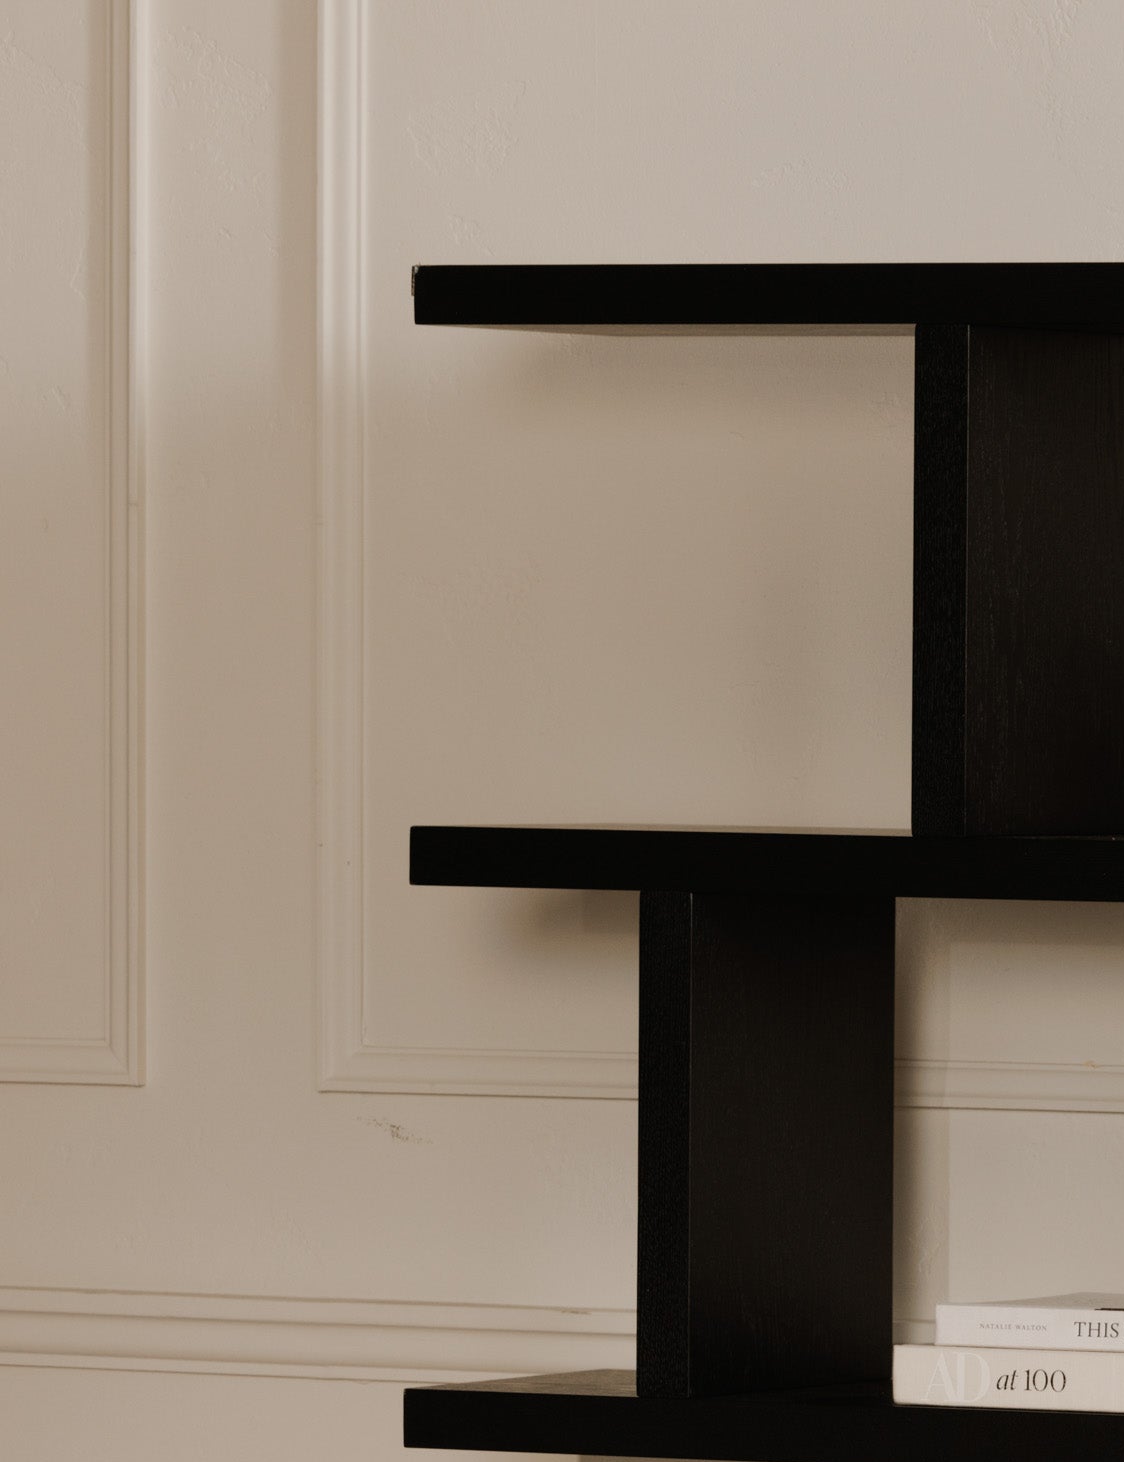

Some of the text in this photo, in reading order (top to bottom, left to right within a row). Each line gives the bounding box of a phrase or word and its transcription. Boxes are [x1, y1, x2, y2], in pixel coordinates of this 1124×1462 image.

[979, 1322, 1048, 1332] NATALIE WALTON
[1073, 1321, 1120, 1338] THIS
[920, 1350, 1067, 1403] AD at 100
